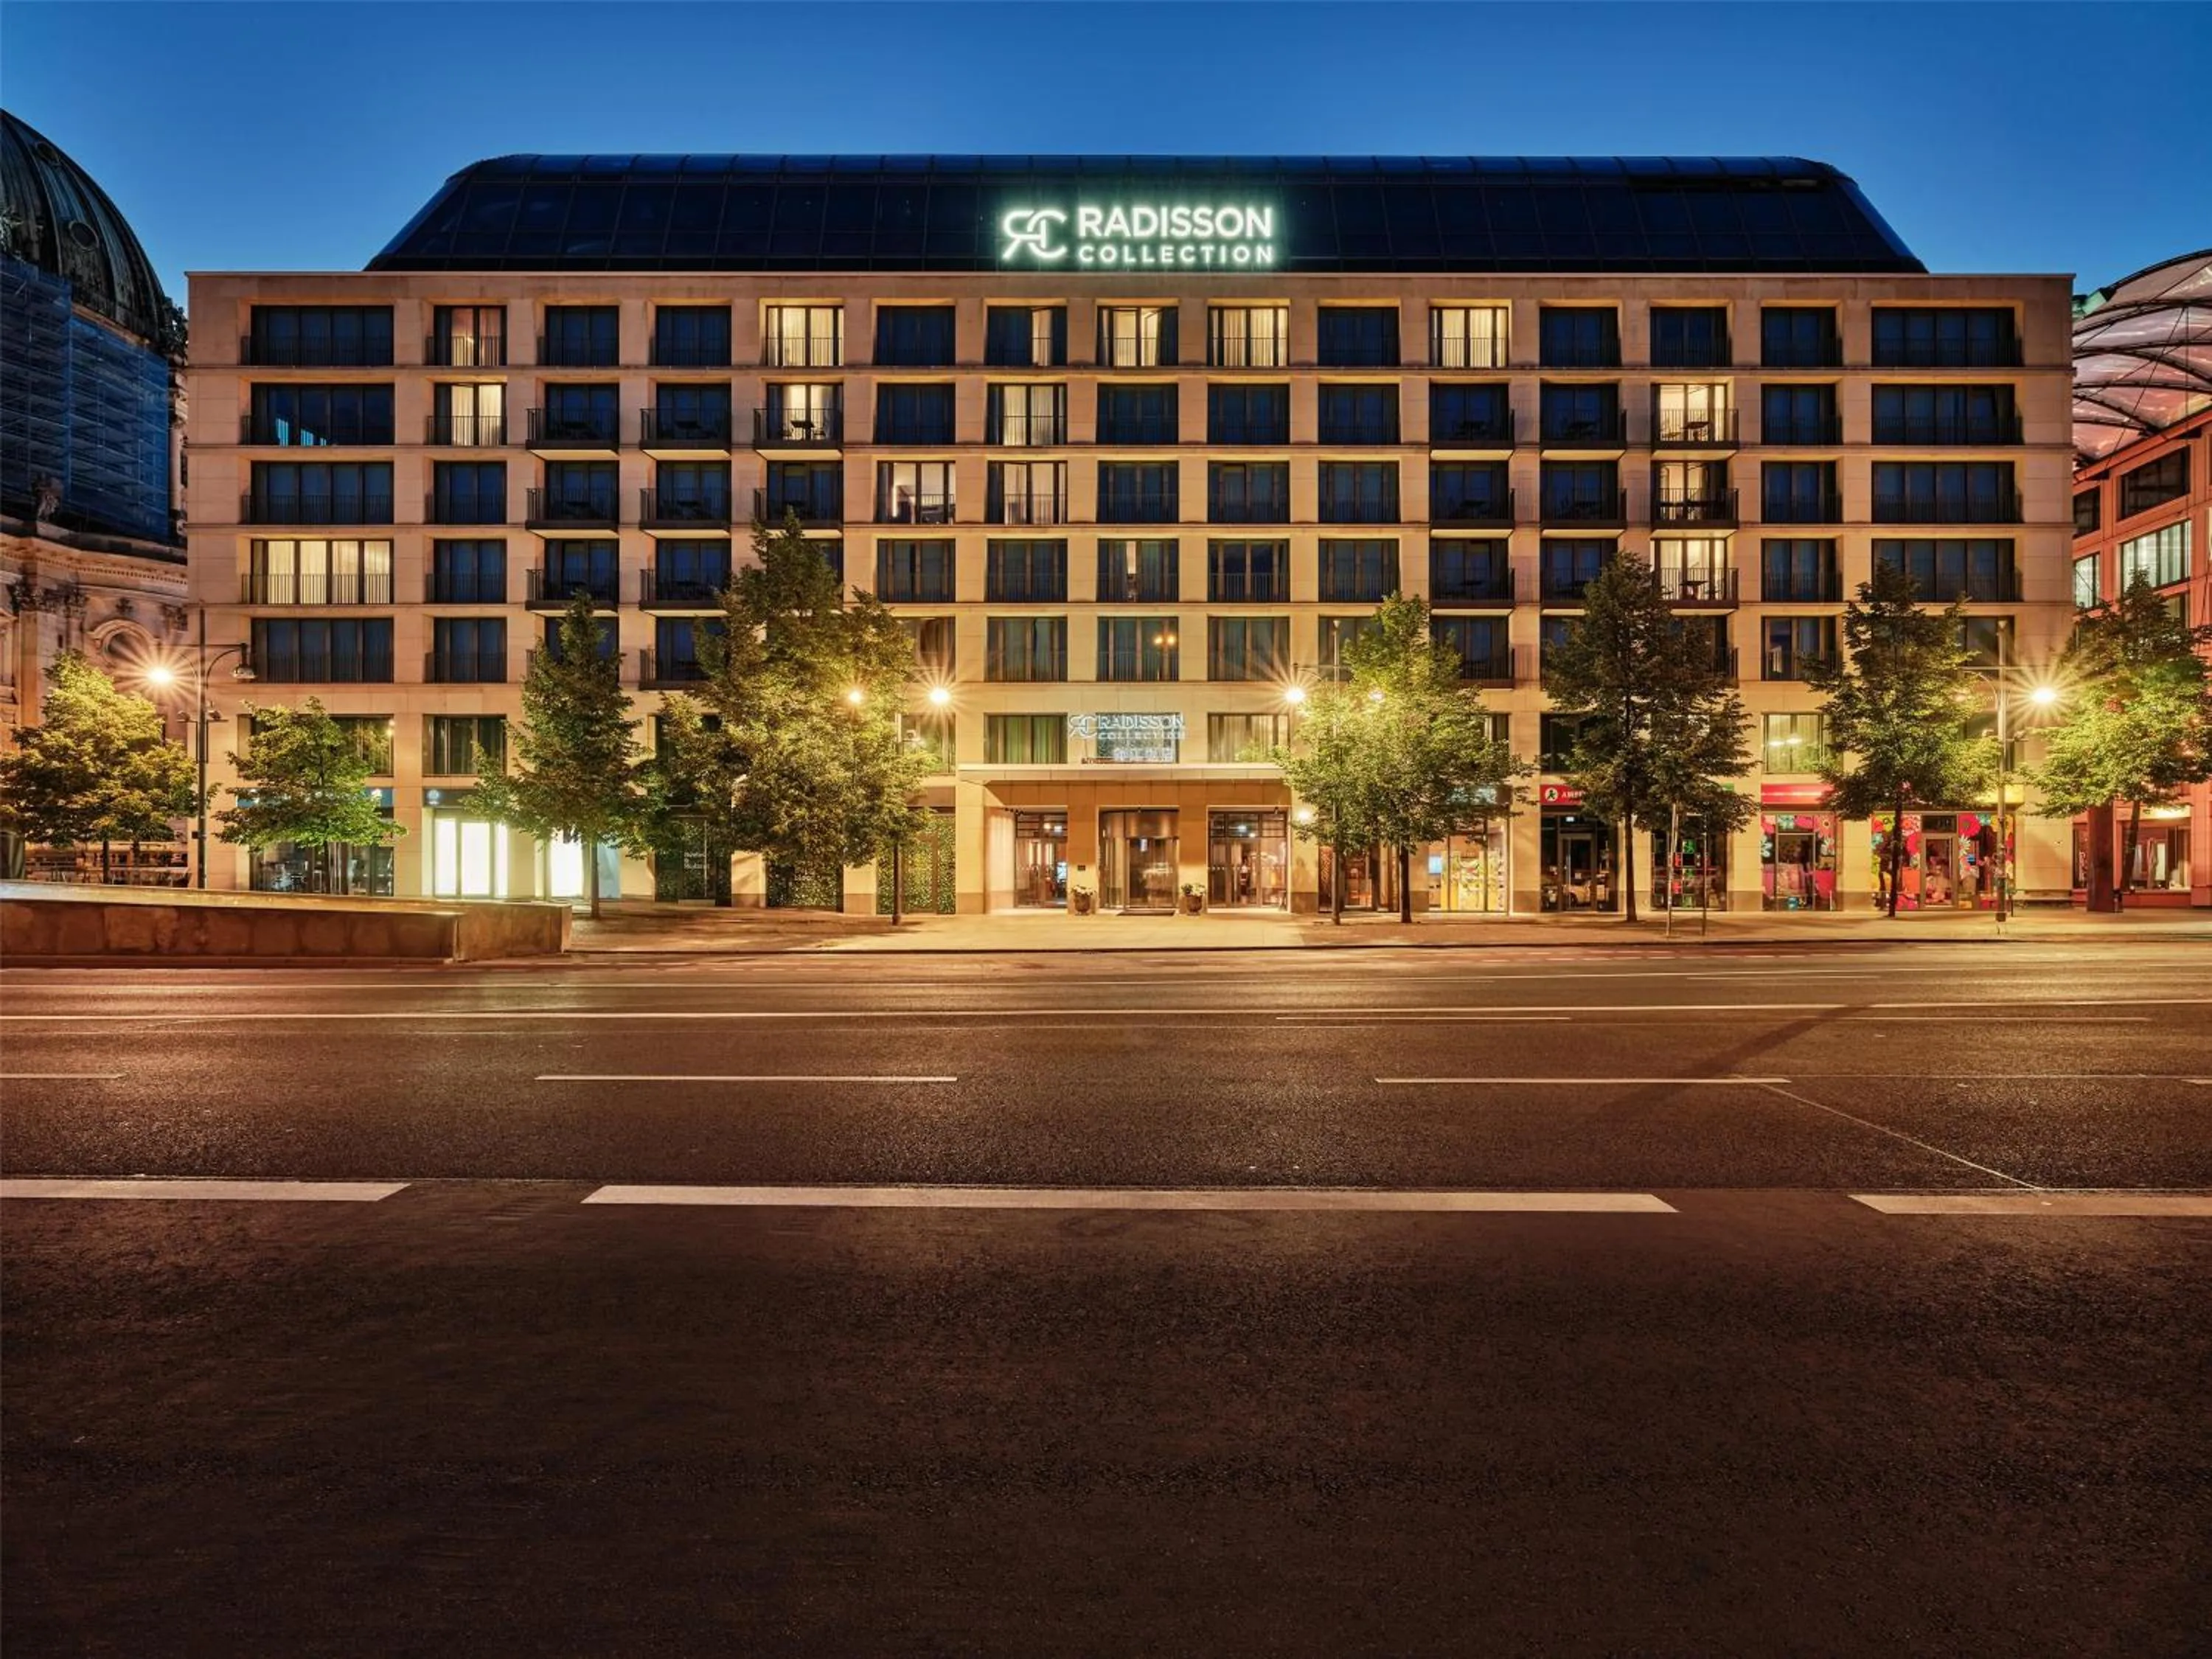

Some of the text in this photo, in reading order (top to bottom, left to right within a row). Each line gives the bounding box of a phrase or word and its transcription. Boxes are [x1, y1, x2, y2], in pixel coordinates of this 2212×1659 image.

[1078, 206, 1273, 238] RADISSON
[1078, 244, 1274, 264] COLLECTION
[1098, 712, 1184, 729] RADISSON
